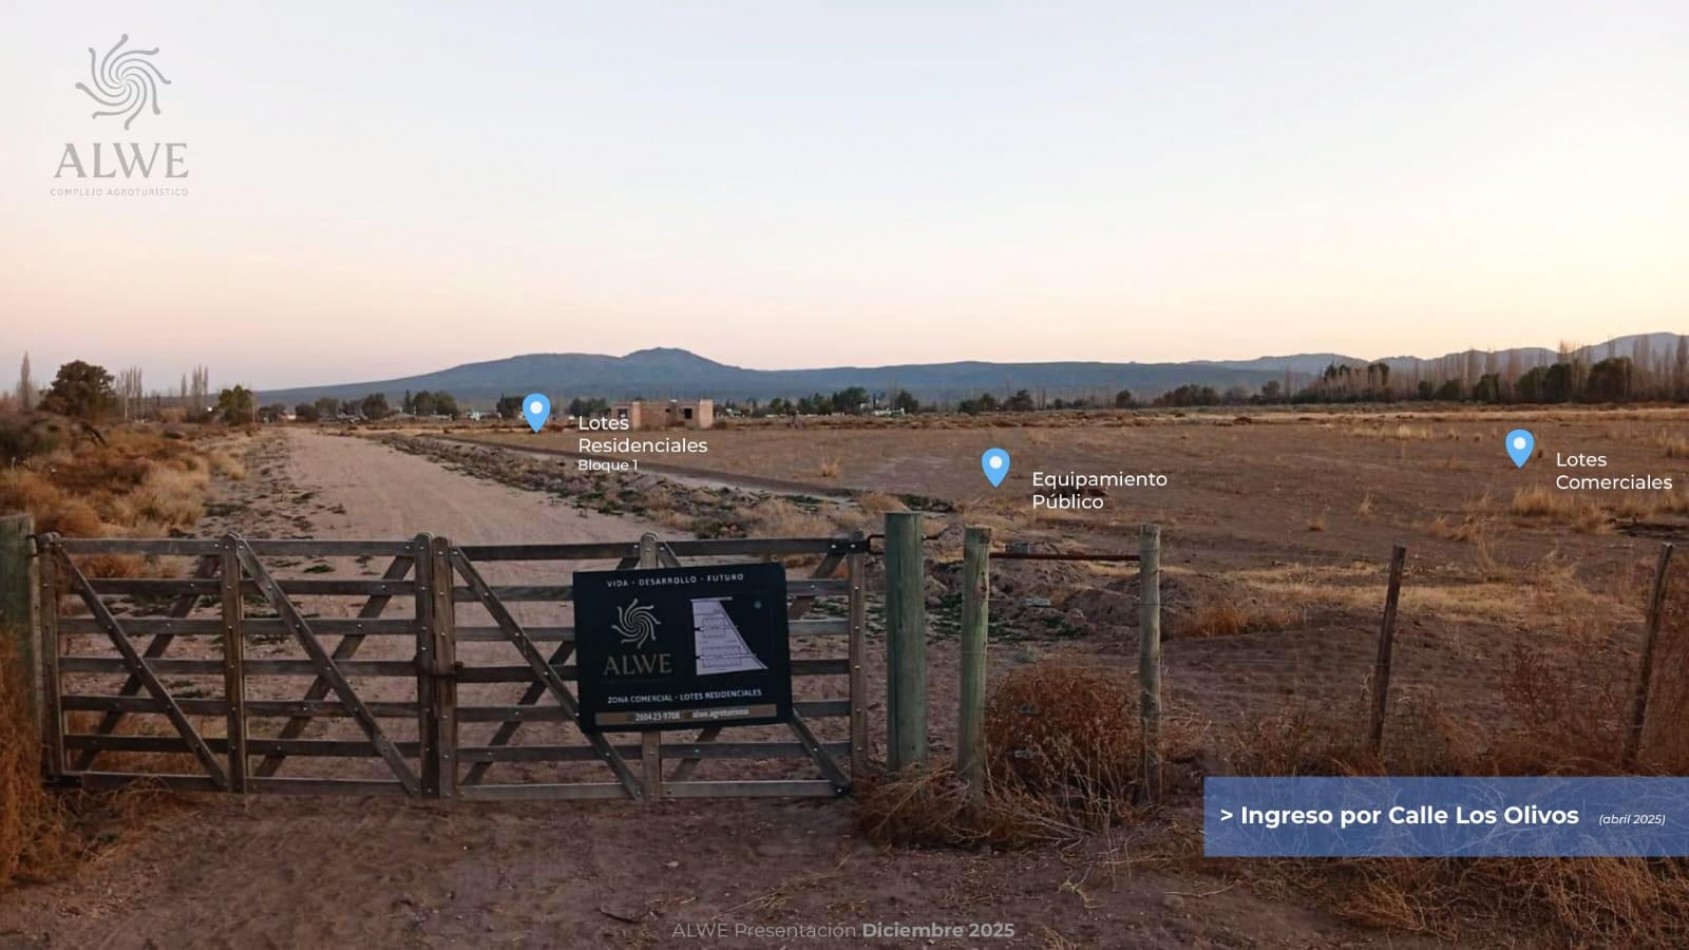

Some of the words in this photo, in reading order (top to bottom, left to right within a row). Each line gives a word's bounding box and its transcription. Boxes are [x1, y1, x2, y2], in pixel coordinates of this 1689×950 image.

[607, 579, 629, 588] VIDA
[639, 575, 698, 587] DESARROLLO
[707, 573, 745, 583] FUTURO
[604, 653, 673, 676] ALWE
[608, 696, 629, 704] ZONA
[630, 694, 674, 703] COMERCIAL
[680, 692, 704, 701] LOTES
[705, 688, 762, 700] RESIDENCIALES
